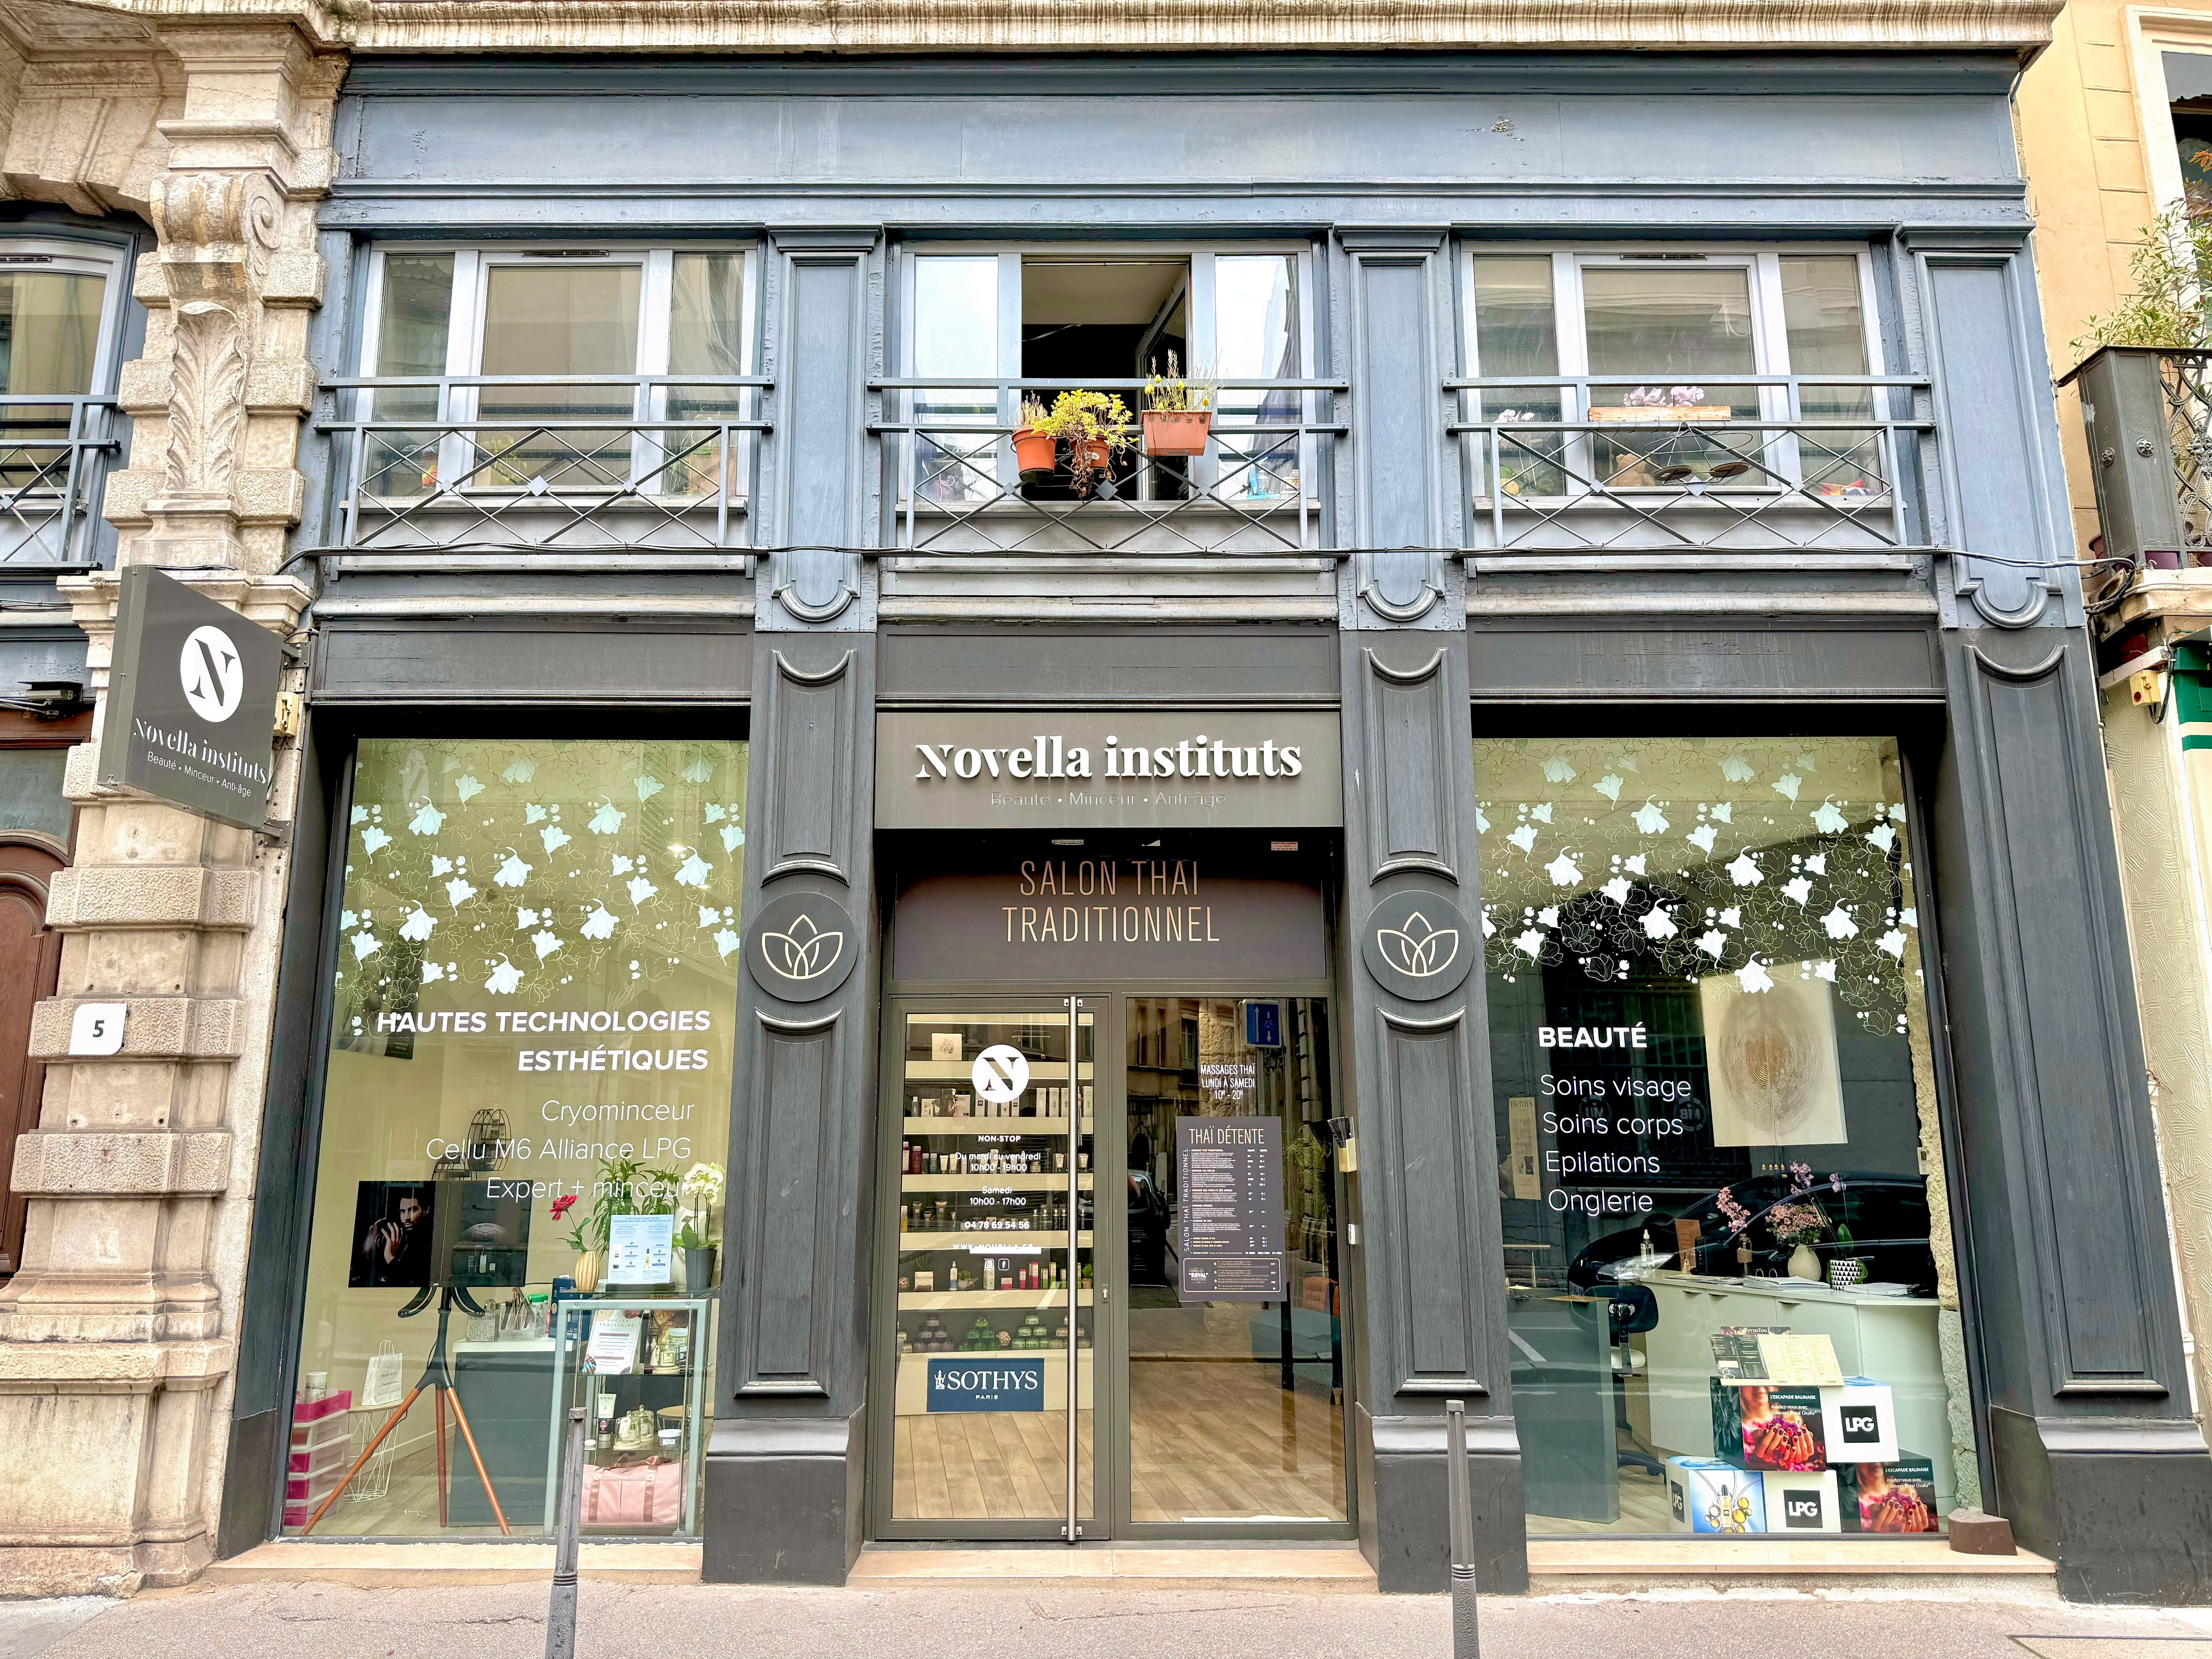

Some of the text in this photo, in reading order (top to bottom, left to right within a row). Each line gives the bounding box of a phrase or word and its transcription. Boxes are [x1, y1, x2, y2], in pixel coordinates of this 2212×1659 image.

[190, 638, 236, 707] N
[133, 717, 267, 784] Novella instituts
[915, 734, 1302, 779] Novella instituts
[148, 751, 251, 797] Beauté Minceur Anti-âge
[991, 790, 1226, 809] Beauté Minceur Anti-âge
[1020, 860, 1115, 895] SALON
[1002, 907, 1220, 942] TRADITIONNEL
[93, 1020, 104, 1037] 5
[377, 1010, 711, 1032] HAUTES TECHNOLOGIES
[1538, 1022, 1647, 1048] BEAUTÉ
[518, 1044, 709, 1071] ESTHÉTIQUES
[1200, 1063, 1255, 1075] MASSAGES THAÏ
[982, 1057, 1020, 1091] N
[1202, 1076, 1255, 1087] LUNDI À SAMEDI
[1540, 1075, 1691, 1102] Soins visage
[542, 1099, 695, 1126] Cryominceur
[1189, 1125, 1264, 1144] THAÏ DÉTENTE
[1543, 1113, 1608, 1134] Soins
[1617, 1116, 1683, 1139] corps
[426, 1137, 691, 1159] Cellu M6 Alliance LPG
[1546, 1150, 1660, 1176] Epilations
[486, 1177, 562, 1203] Expert
[571, 1181, 584, 1194] +
[982, 1186, 1012, 1194] Samedi
[1549, 1188, 1653, 1216] Onglerie
[947, 1370, 1038, 1390] SOTHYS
[1845, 1417, 1874, 1432] LPG
[1672, 1492, 1683, 1510] LPG
[1788, 1501, 1818, 1517] LPG
